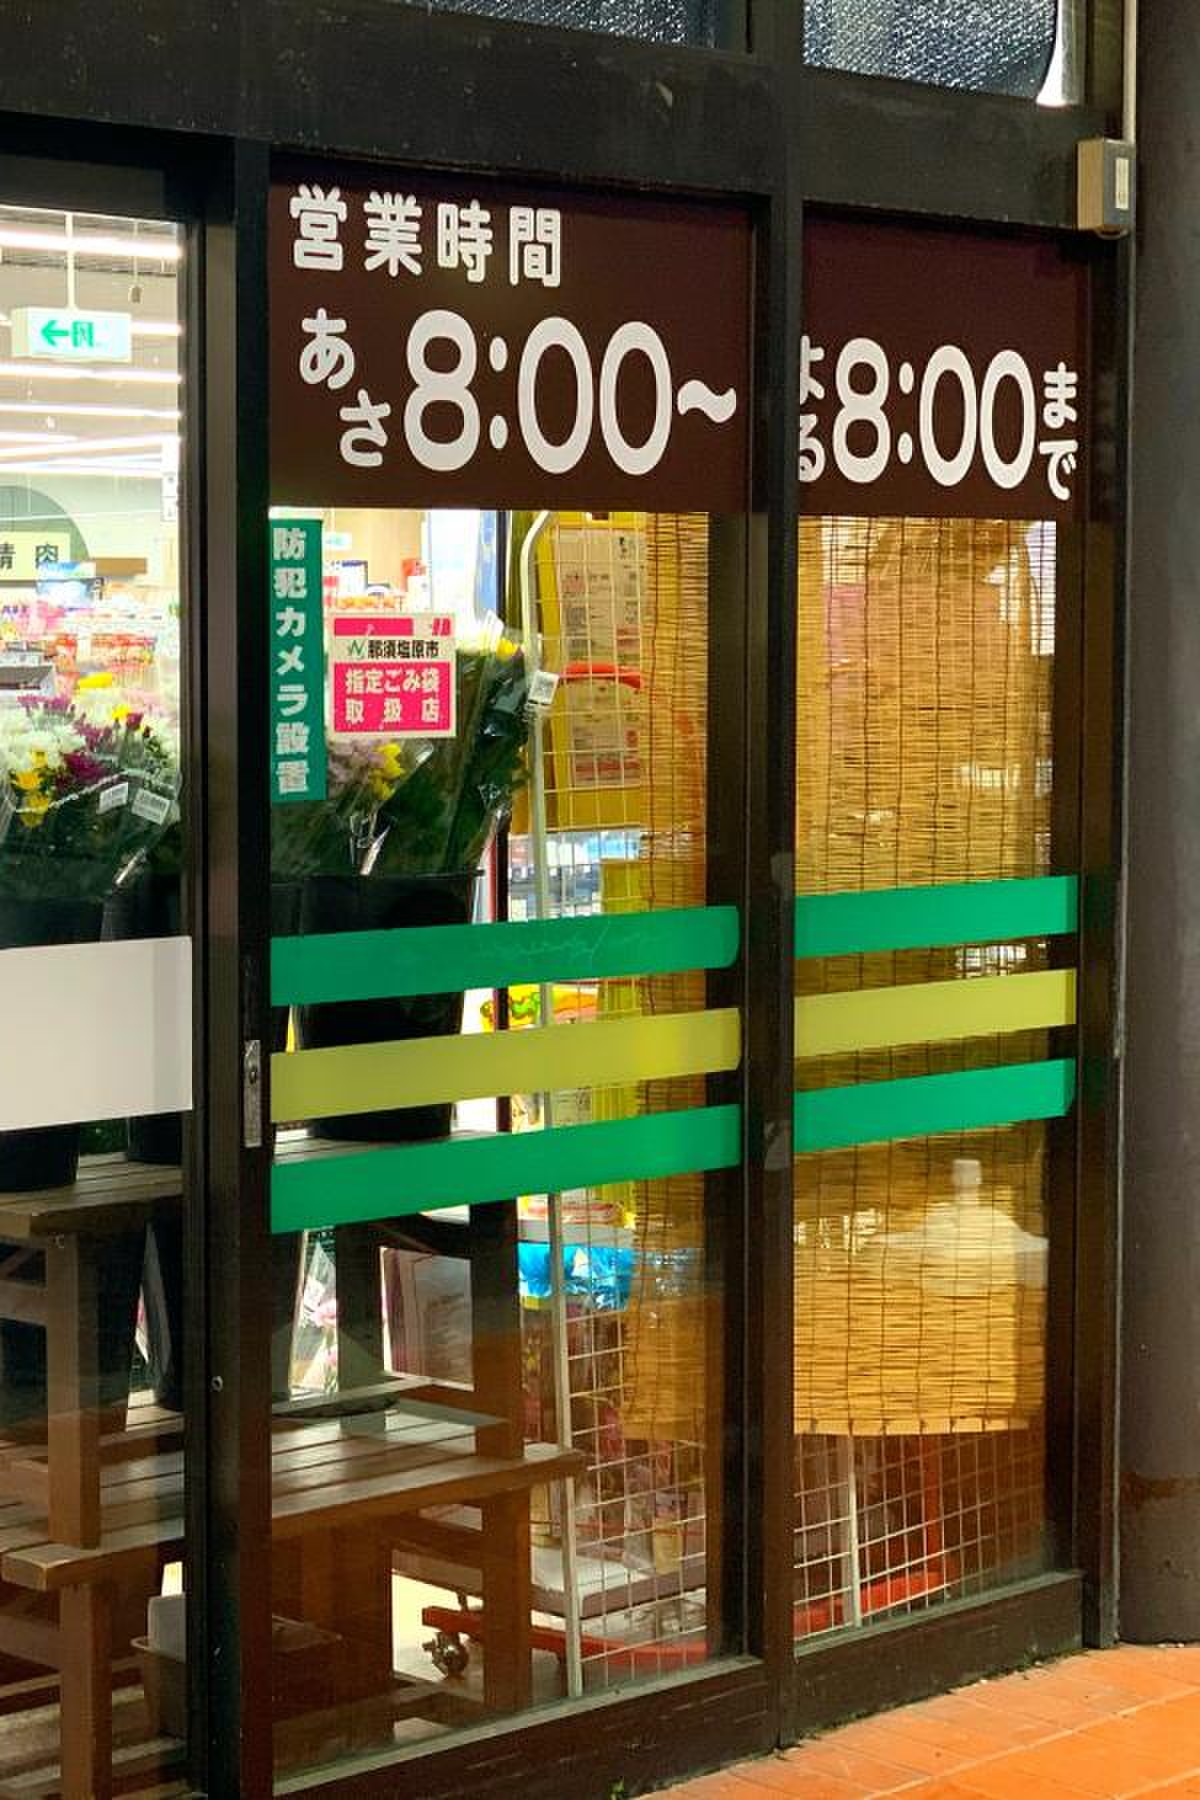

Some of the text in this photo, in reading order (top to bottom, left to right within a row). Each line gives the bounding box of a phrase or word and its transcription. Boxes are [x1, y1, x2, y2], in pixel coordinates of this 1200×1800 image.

[289, 184, 561, 288] 営業時間
[299, 307, 391, 467] あさ
[832, 337, 1037, 489] 8:00
[1039, 361, 1079, 501] まで
[272, 526, 310, 795] 防犯カメラ設置
[345, 667, 441, 695] 指定ごみ袋
[367, 638, 440, 660] 那須塩原市
